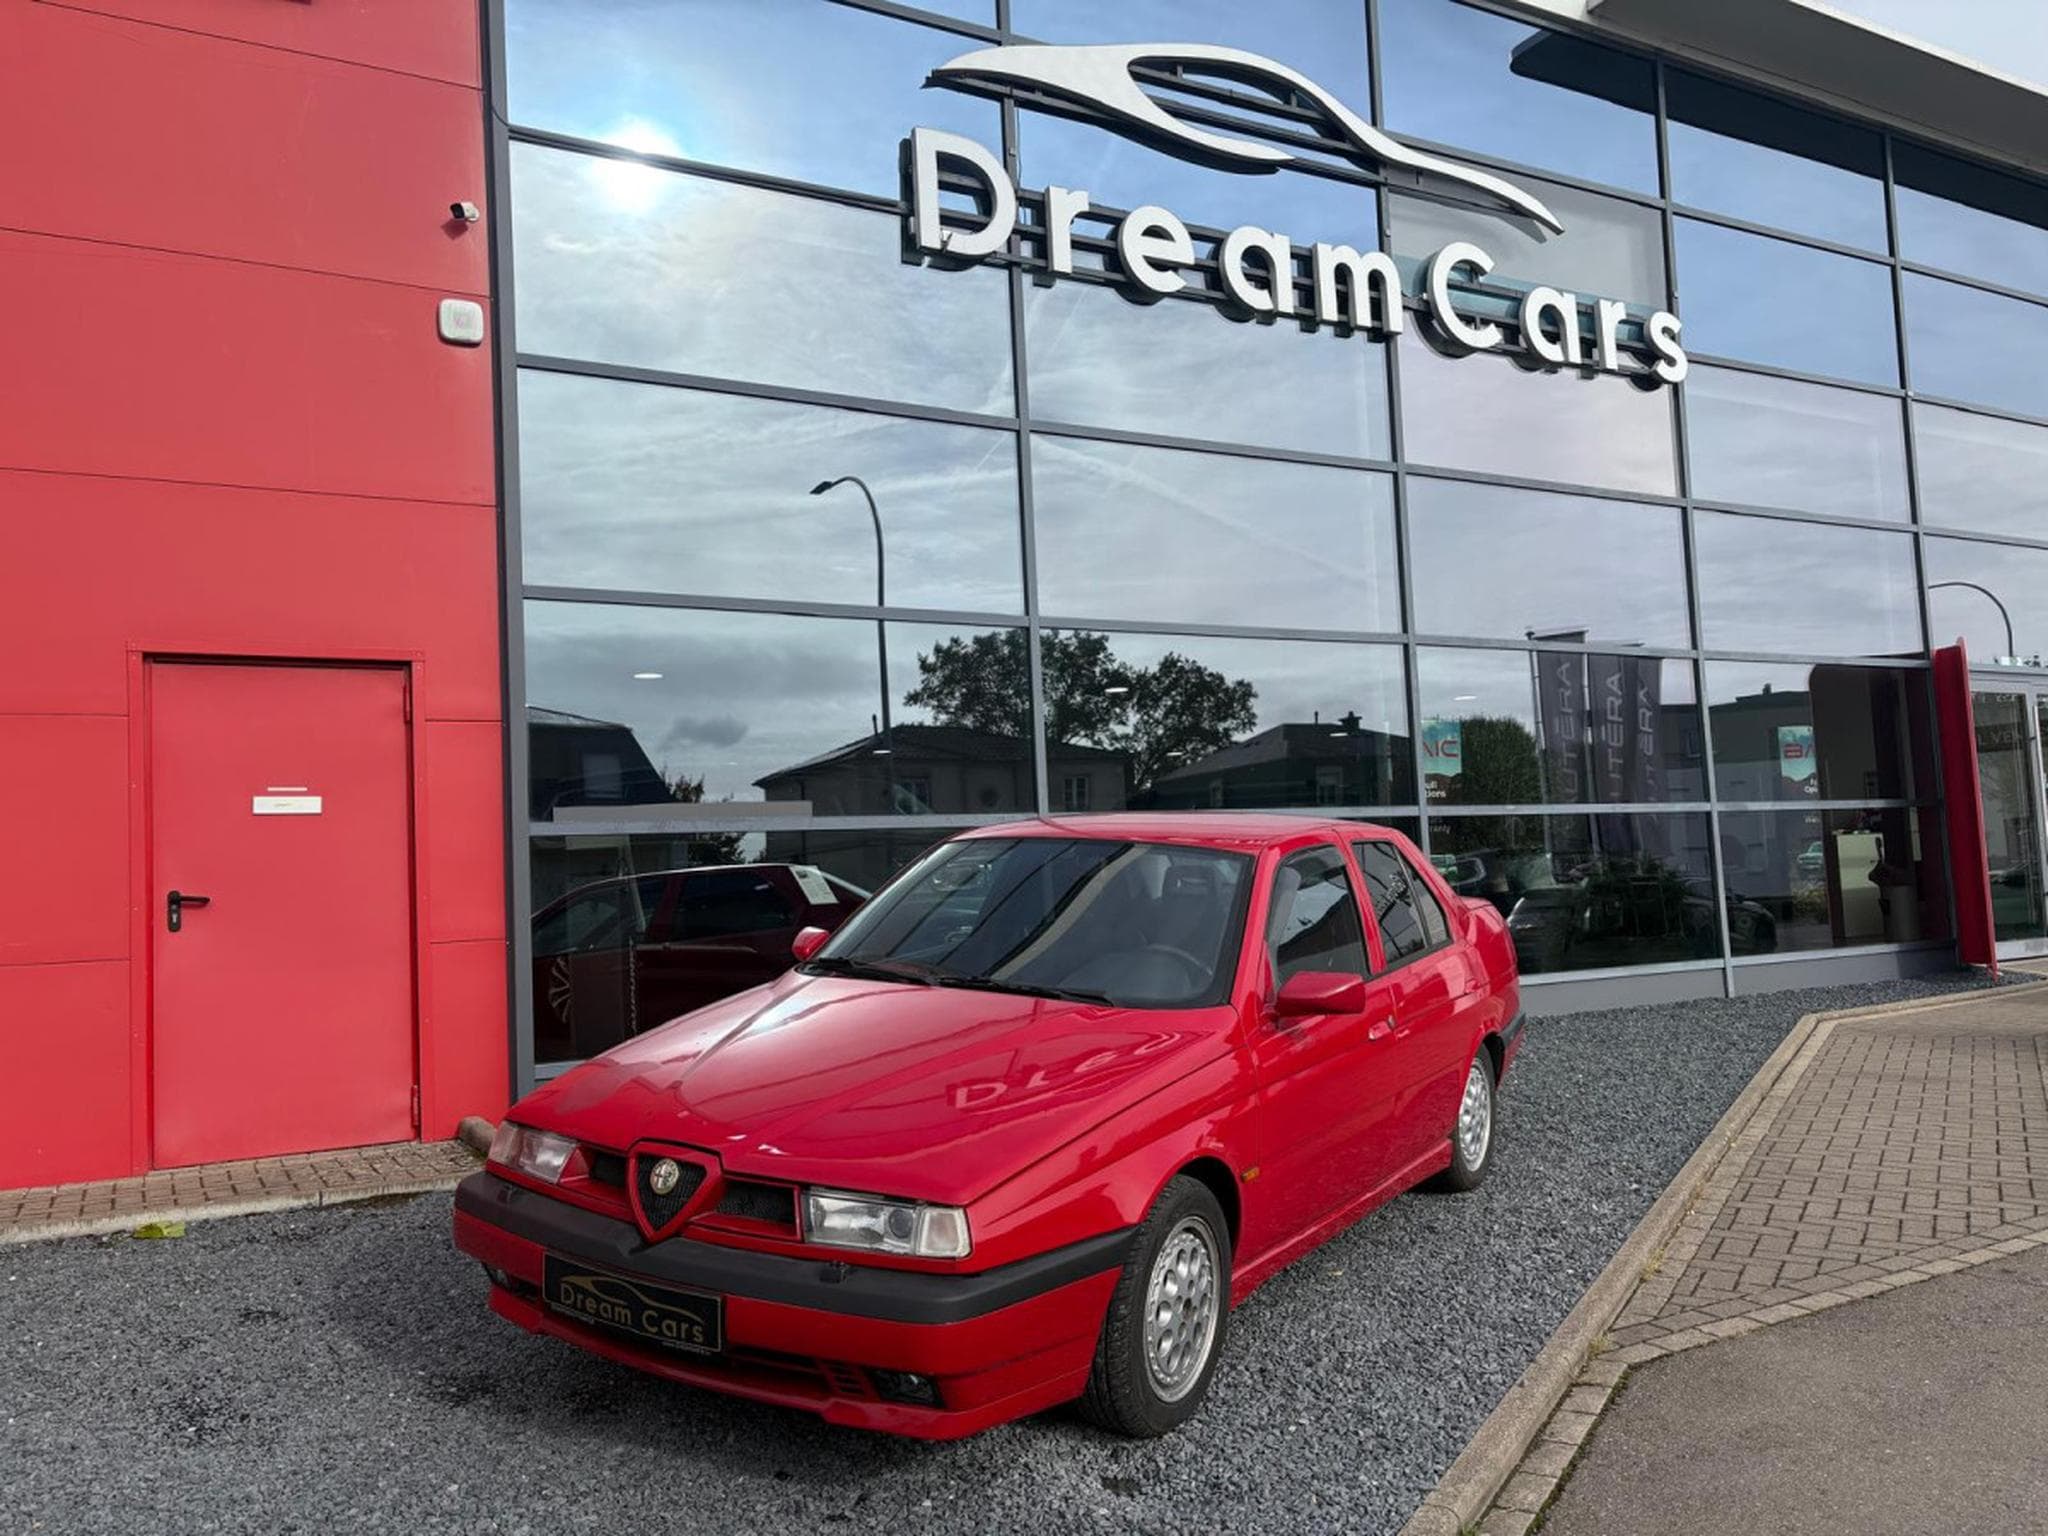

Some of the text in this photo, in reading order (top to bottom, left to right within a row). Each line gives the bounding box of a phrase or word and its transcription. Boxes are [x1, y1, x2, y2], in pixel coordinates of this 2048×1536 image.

[911, 126, 1689, 385] Dream Cars
[560, 1283, 632, 1326] Dream
[641, 1309, 705, 1344] Cars
